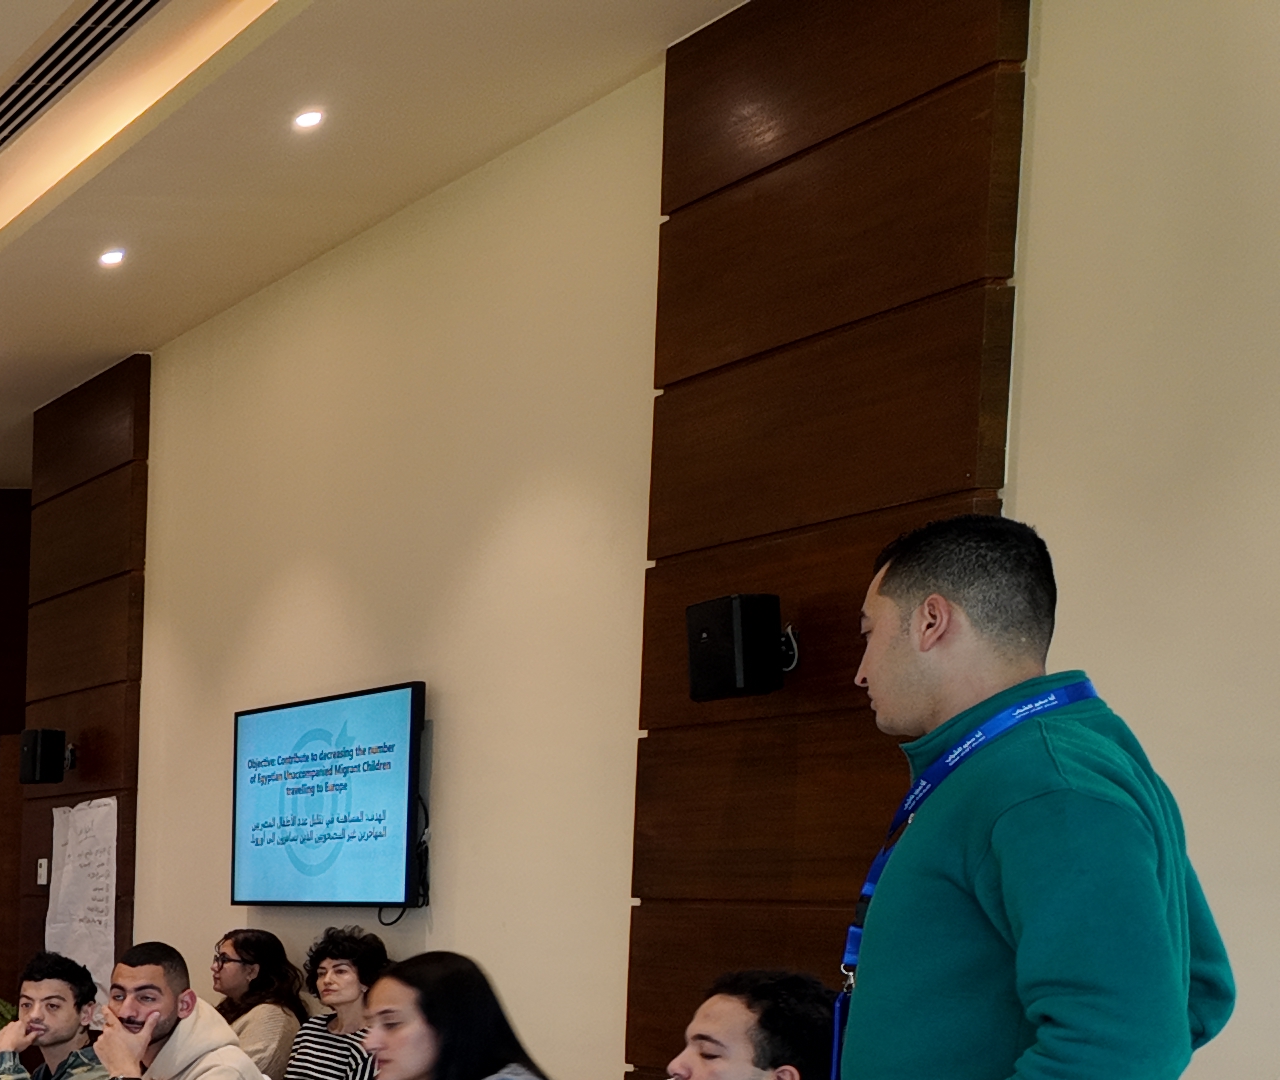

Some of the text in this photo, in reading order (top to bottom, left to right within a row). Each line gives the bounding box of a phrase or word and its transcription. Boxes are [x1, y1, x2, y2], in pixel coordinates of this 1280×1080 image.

[277, 752, 310, 766] Contribute
[311, 752, 318, 762] to
[319, 746, 354, 761] decreasing
[355, 744, 366, 757] the
[367, 741, 396, 755] number
[249, 759, 392, 787] of Egyptian Unaccompanied Migrant Children
[286, 781, 348, 797] travelling to Europe
